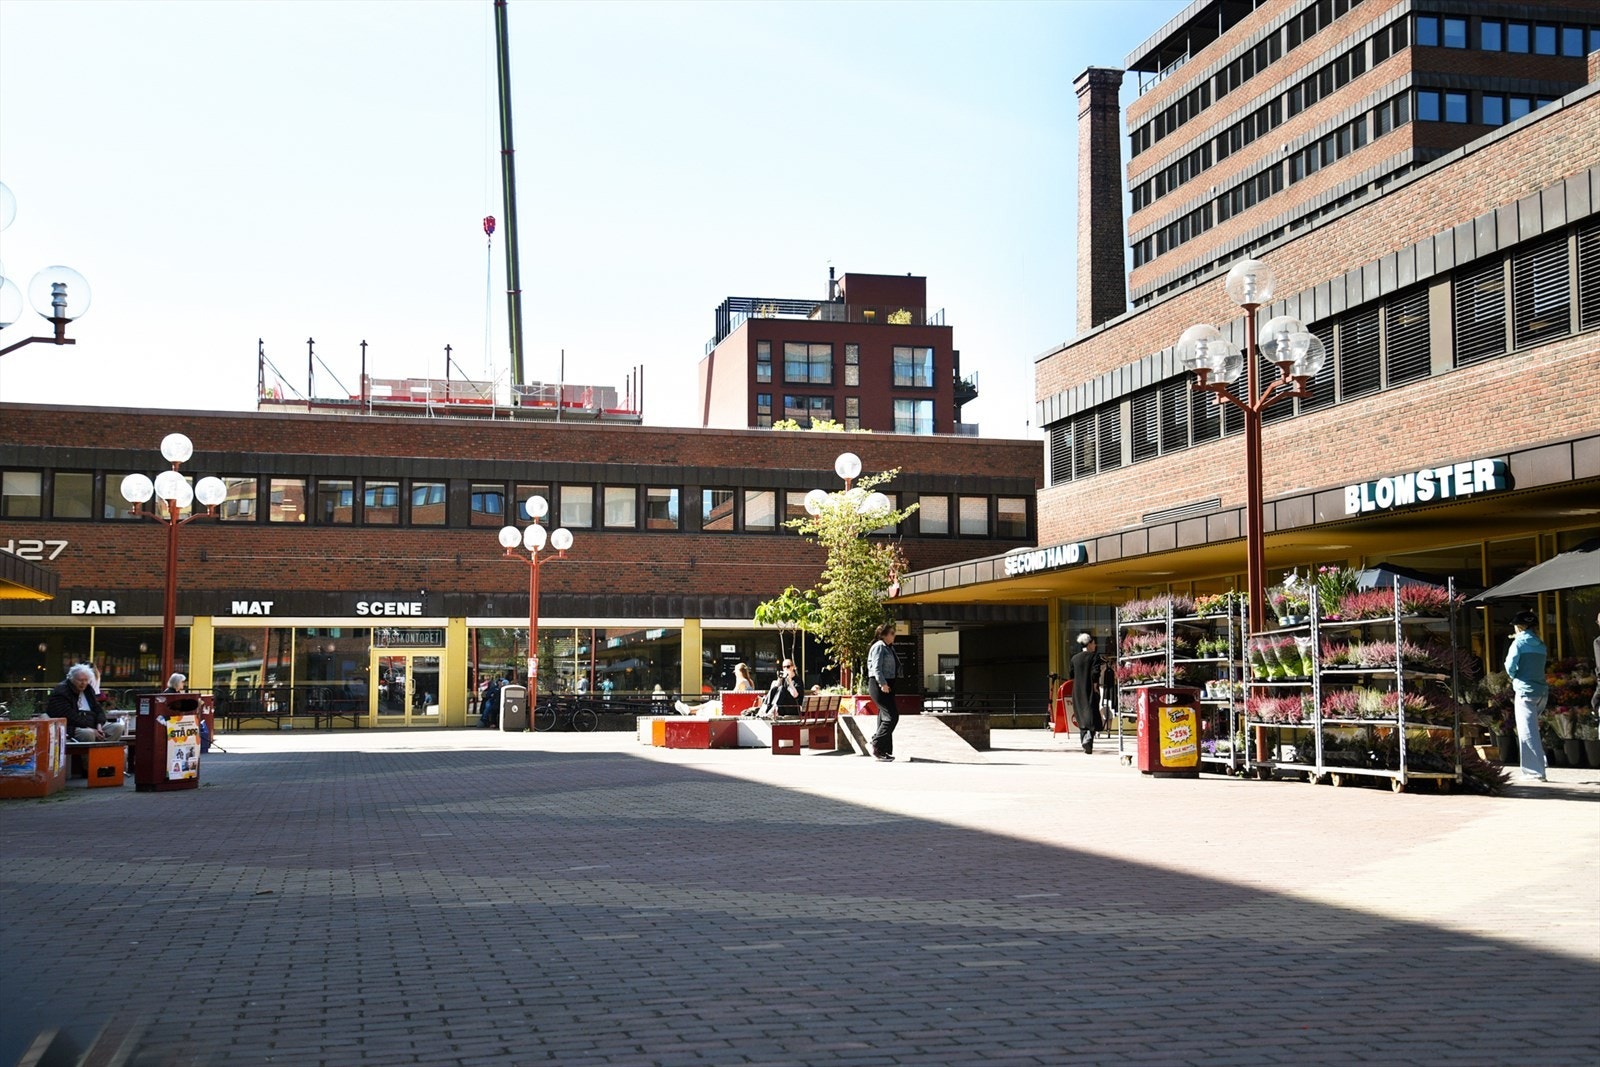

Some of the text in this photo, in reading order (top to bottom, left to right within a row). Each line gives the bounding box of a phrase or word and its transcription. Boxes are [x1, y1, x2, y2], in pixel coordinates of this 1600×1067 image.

[1345, 459, 1496, 514] BLOMSTER
[1004, 543, 1080, 575] SECOND HAND
[71, 600, 116, 614] BAR
[232, 601, 274, 615] MAT
[356, 601, 423, 616] SCENE
[170, 727, 185, 738] STÅ
